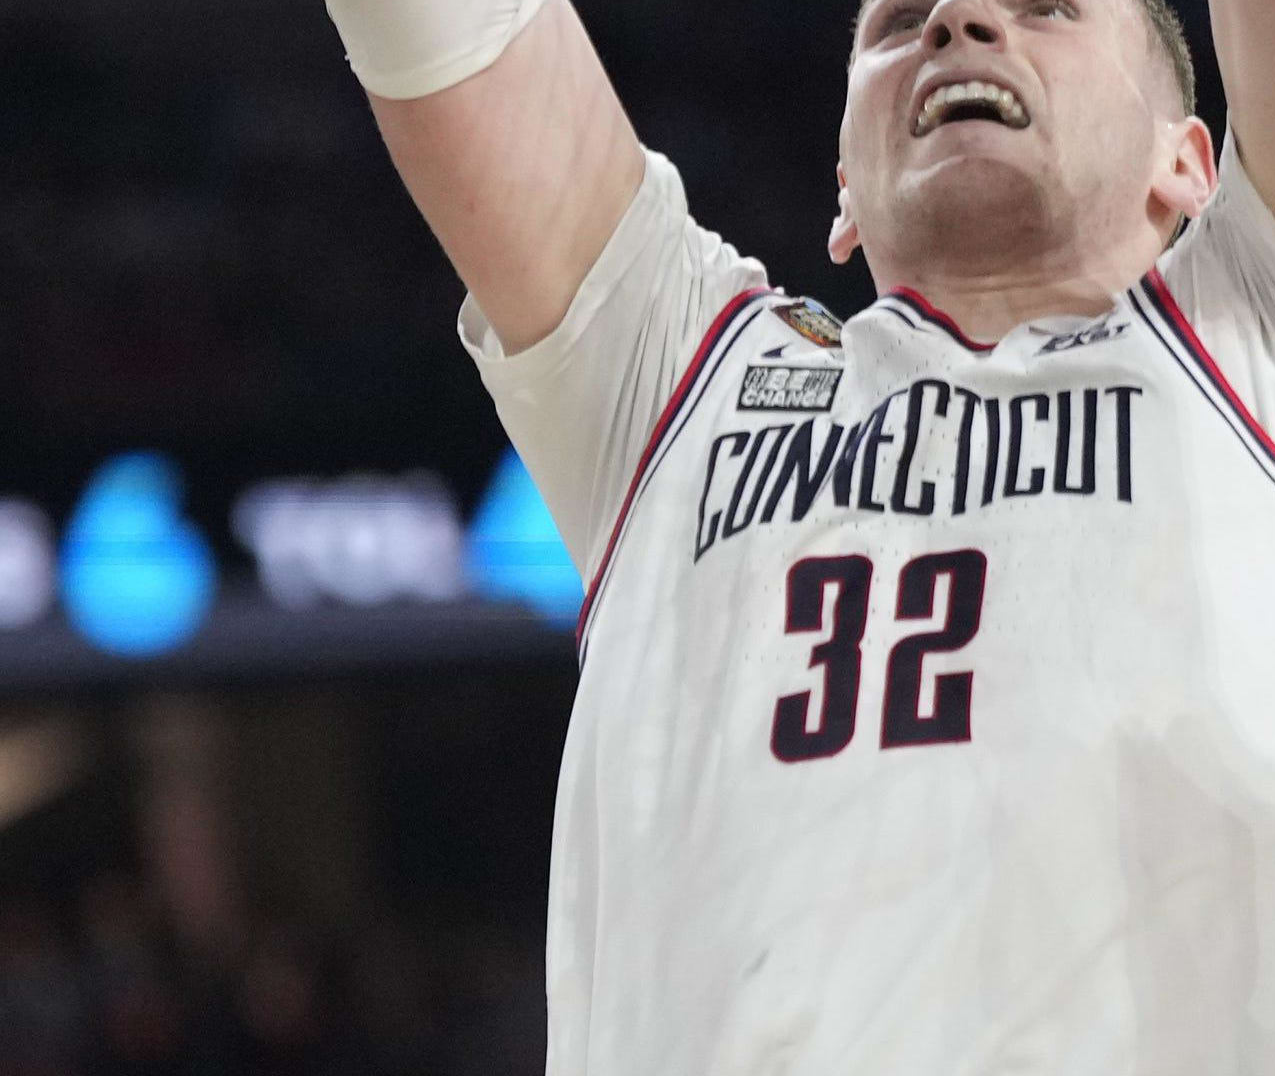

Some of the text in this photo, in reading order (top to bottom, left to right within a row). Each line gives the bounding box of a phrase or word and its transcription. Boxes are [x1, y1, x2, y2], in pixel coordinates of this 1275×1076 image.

[694, 378, 1143, 564] CONNECTICUT
[740, 388, 832, 407] CHANGE
[769, 547, 989, 764] 32
